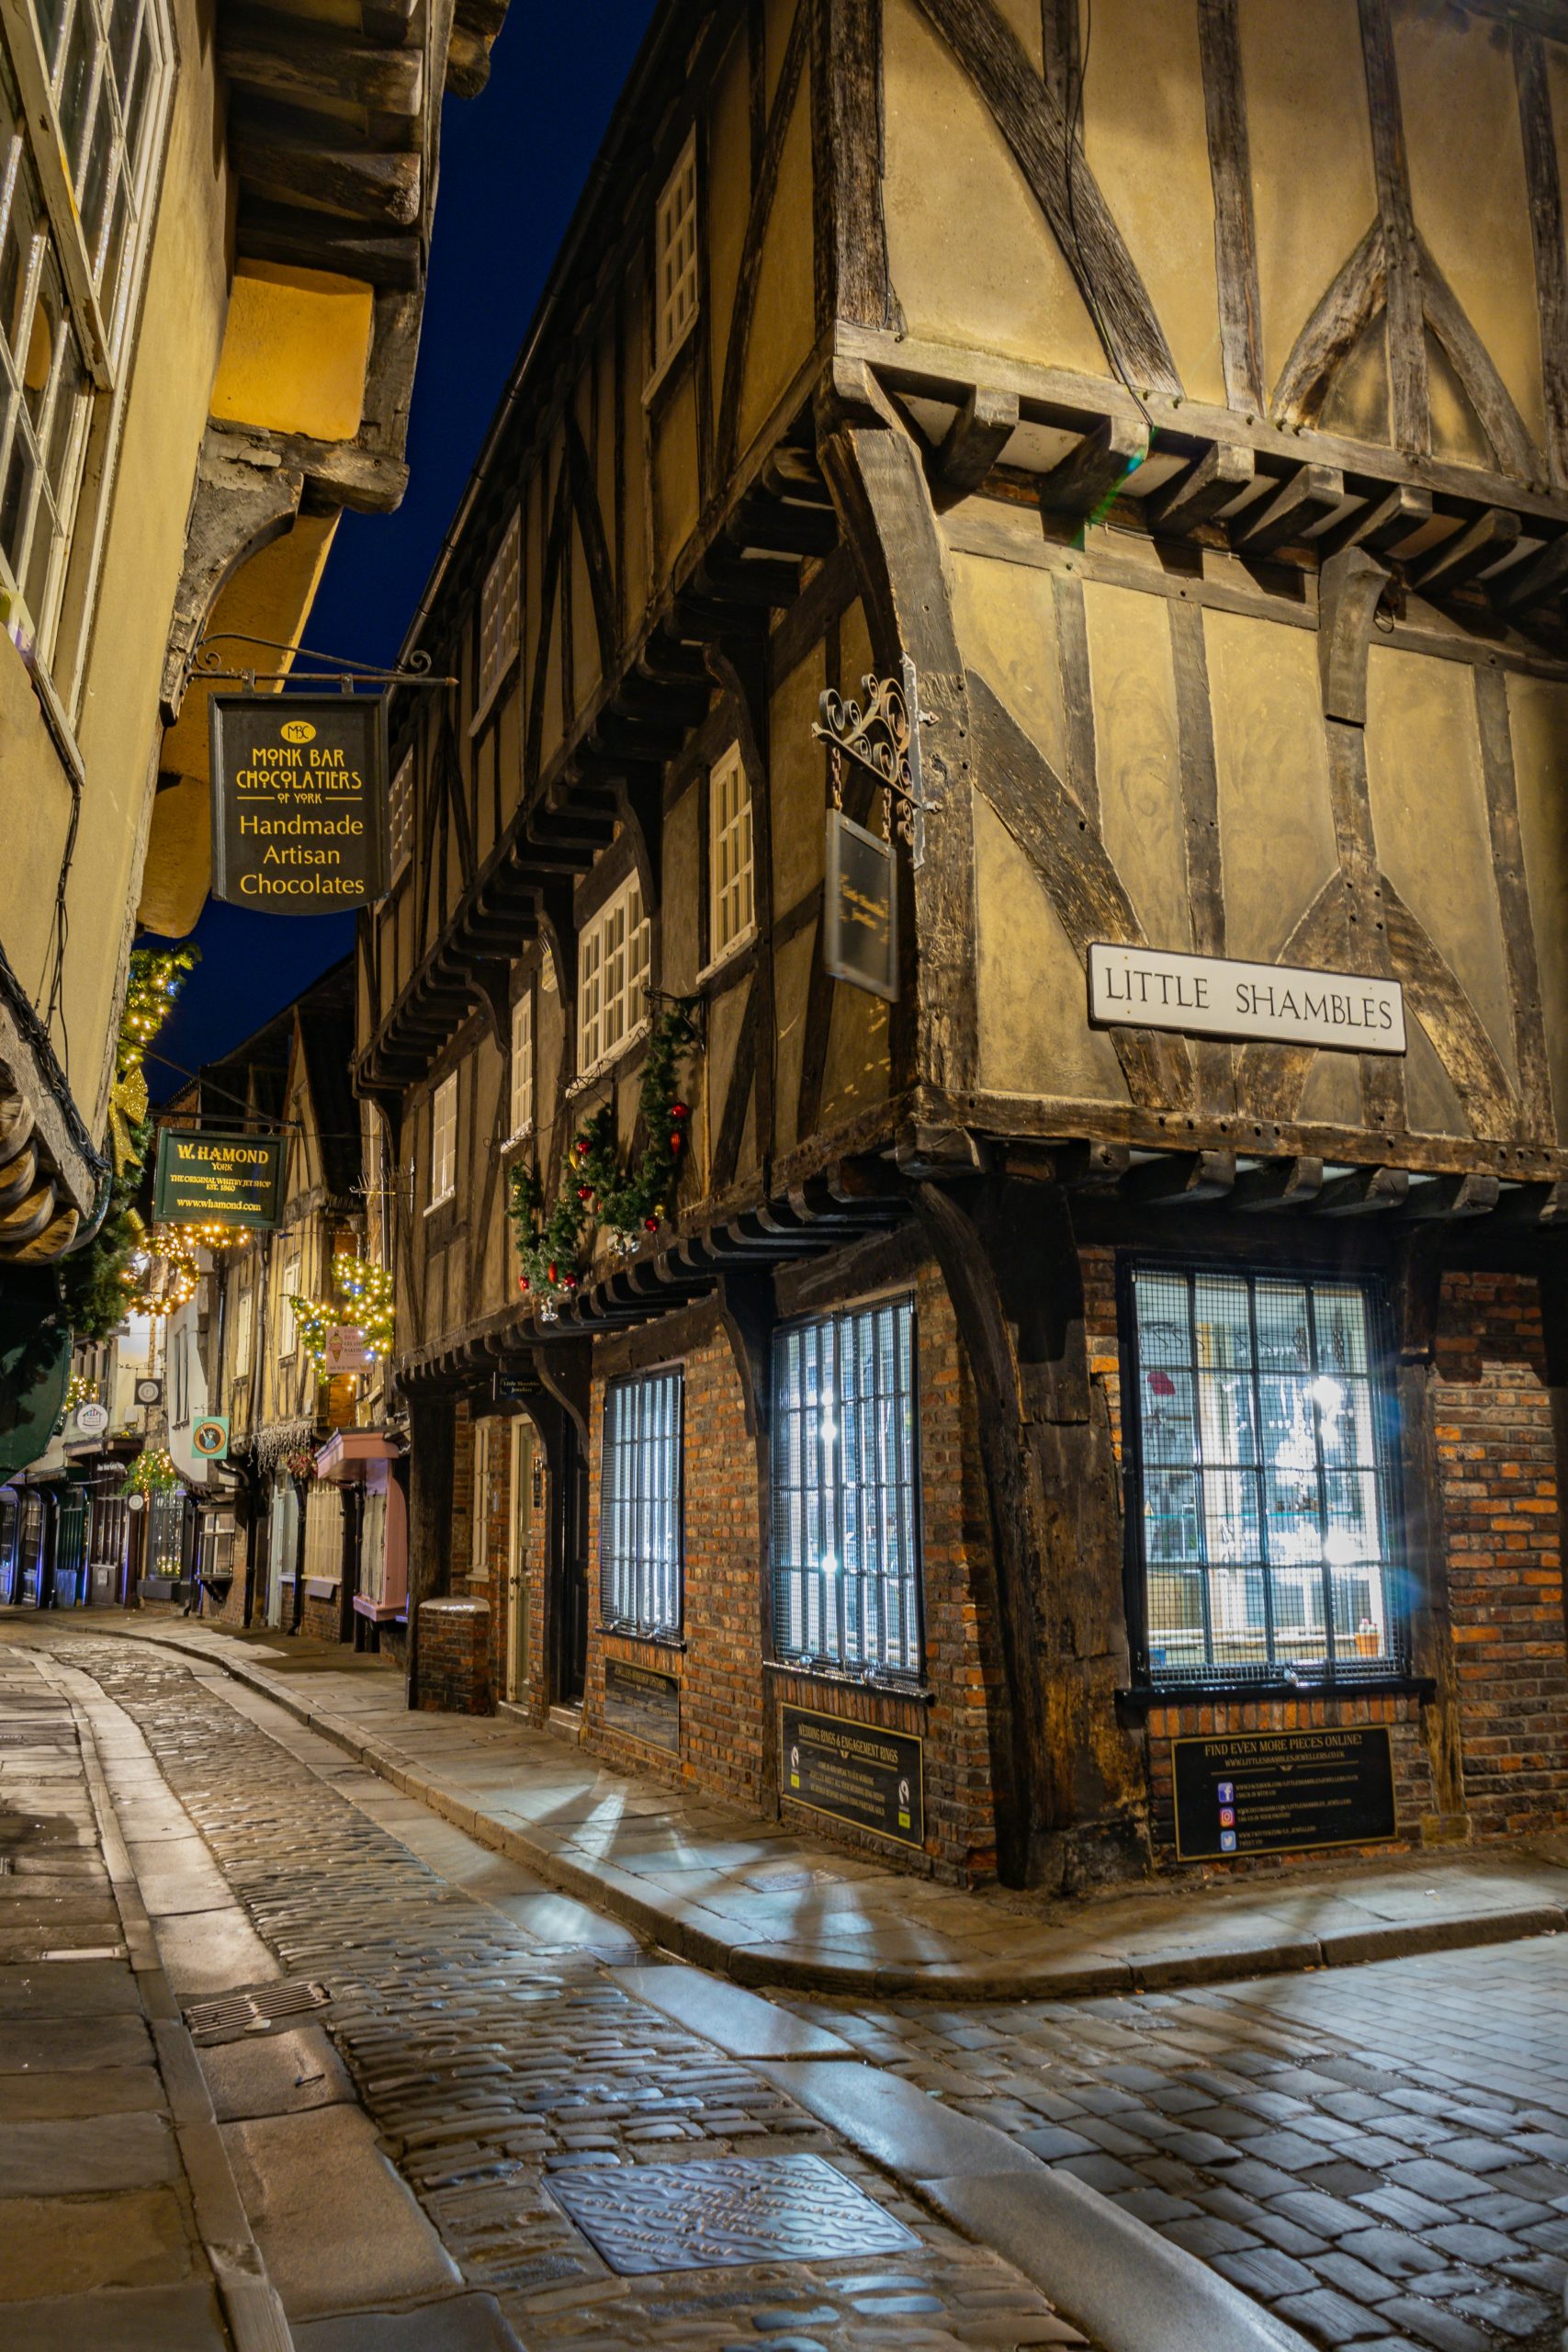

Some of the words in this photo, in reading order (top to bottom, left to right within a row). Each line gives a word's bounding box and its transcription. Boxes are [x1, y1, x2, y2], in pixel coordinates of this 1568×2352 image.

[288, 725, 310, 740] MBC
[252, 748, 303, 768] MONK
[310, 748, 345, 768] BAR
[235, 770, 363, 790] CHOCOLATIERS
[276, 792, 290, 805] OF
[293, 792, 322, 805] YORK
[239, 814, 364, 836] Handmade
[263, 844, 341, 865] Artisan
[239, 872, 365, 895] Chocolates
[1105, 967, 1211, 1009] LITTLE
[1235, 982, 1393, 1030] SHAMBLES
[176, 1143, 196, 1160] W.
[197, 1146, 270, 1164] HAMOND
[212, 1161, 234, 1172] YORK
[170, 1174, 185, 1182] THE
[185, 1175, 216, 1185] ORIGINAL
[216, 1178, 242, 1187] WHITBY
[243, 1179, 253, 1188] JET
[254, 1181, 272, 1189] SHOP
[176, 1198, 262, 1212] www.whamond.com
[798, 1724, 820, 1742] WEDDING
[820, 1731, 836, 1746] RINGS
[841, 1736, 878, 1758] ENGAGEMENT
[880, 1746, 898, 1764] RINGS
[1205, 1744, 1228, 1757] FIND
[1231, 1742, 1257, 1755] EVEN
[1259, 1739, 1287, 1753] MORE
[1290, 1736, 1324, 1750] PIECES
[1325, 1734, 1362, 1747] ONLINE!
